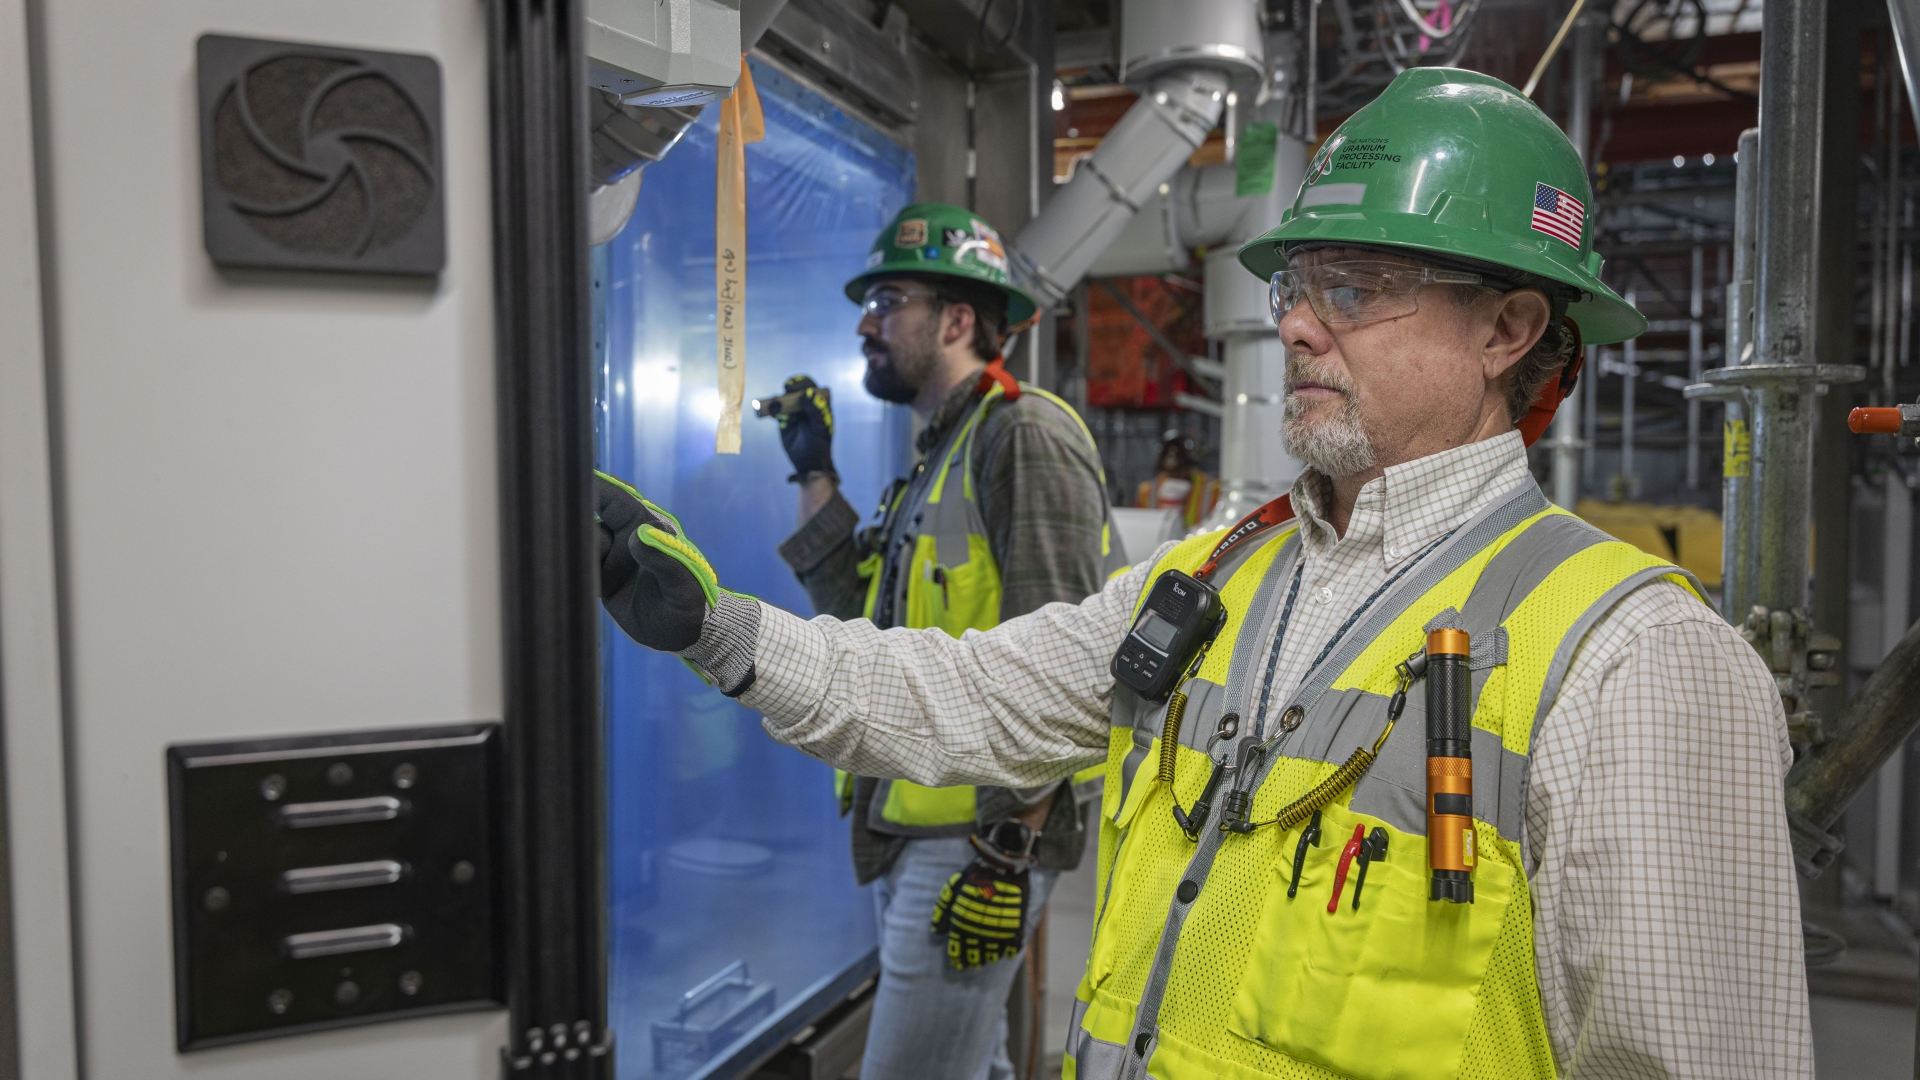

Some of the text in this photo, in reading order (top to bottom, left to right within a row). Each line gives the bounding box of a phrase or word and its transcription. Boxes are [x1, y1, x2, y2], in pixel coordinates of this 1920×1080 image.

[1342, 144, 1386, 153] URANIUM
[1338, 152, 1402, 163] PROCESSING
[1335, 161, 1376, 170] FACILITY
[1212, 520, 1258, 558] PROTO
